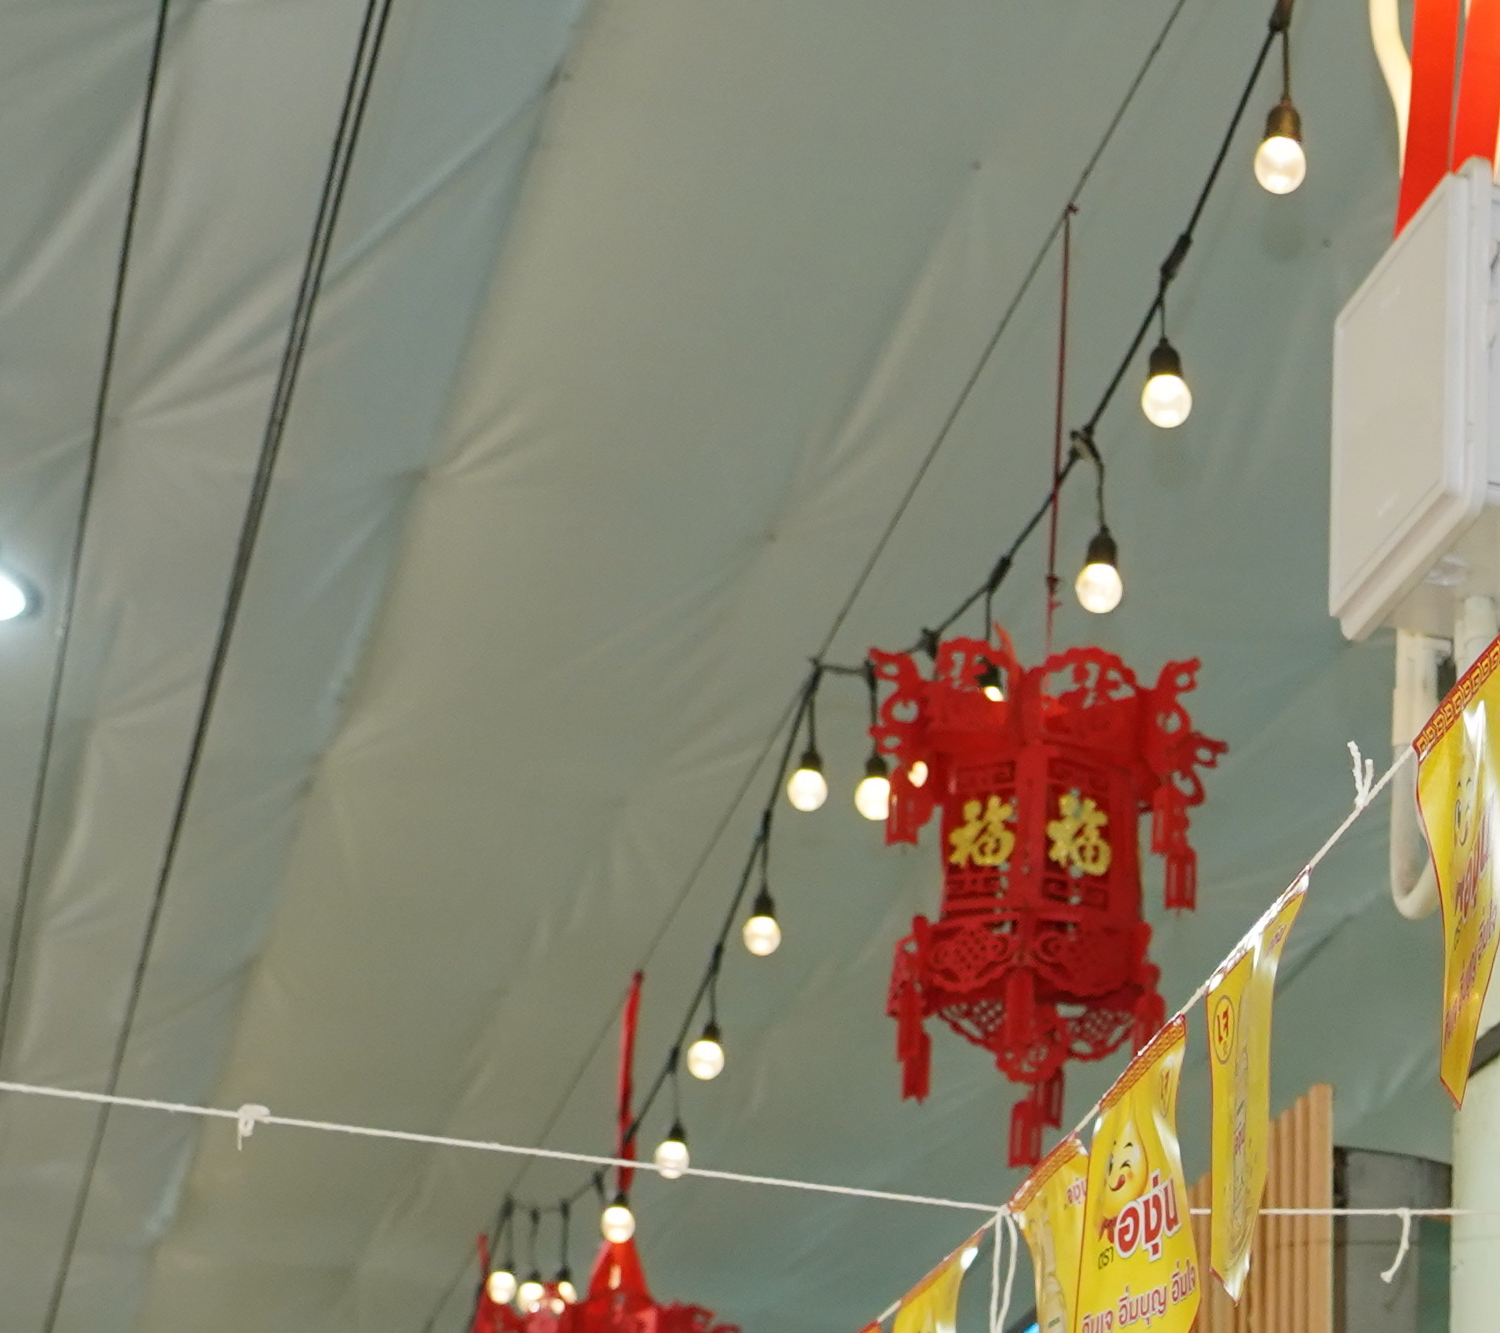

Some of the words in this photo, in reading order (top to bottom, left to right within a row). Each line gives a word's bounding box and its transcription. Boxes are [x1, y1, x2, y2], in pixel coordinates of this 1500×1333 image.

[950, 794, 1016, 867] 福
[1048, 793, 1111, 876] 福
[1097, 1247, 1115, 1271] ตรา
[1115, 1171, 1180, 1260] องุ่น
[1118, 1286, 1168, 1328] อิ่มบุญ
[1171, 1258, 1197, 1303] อิ่มใจ
